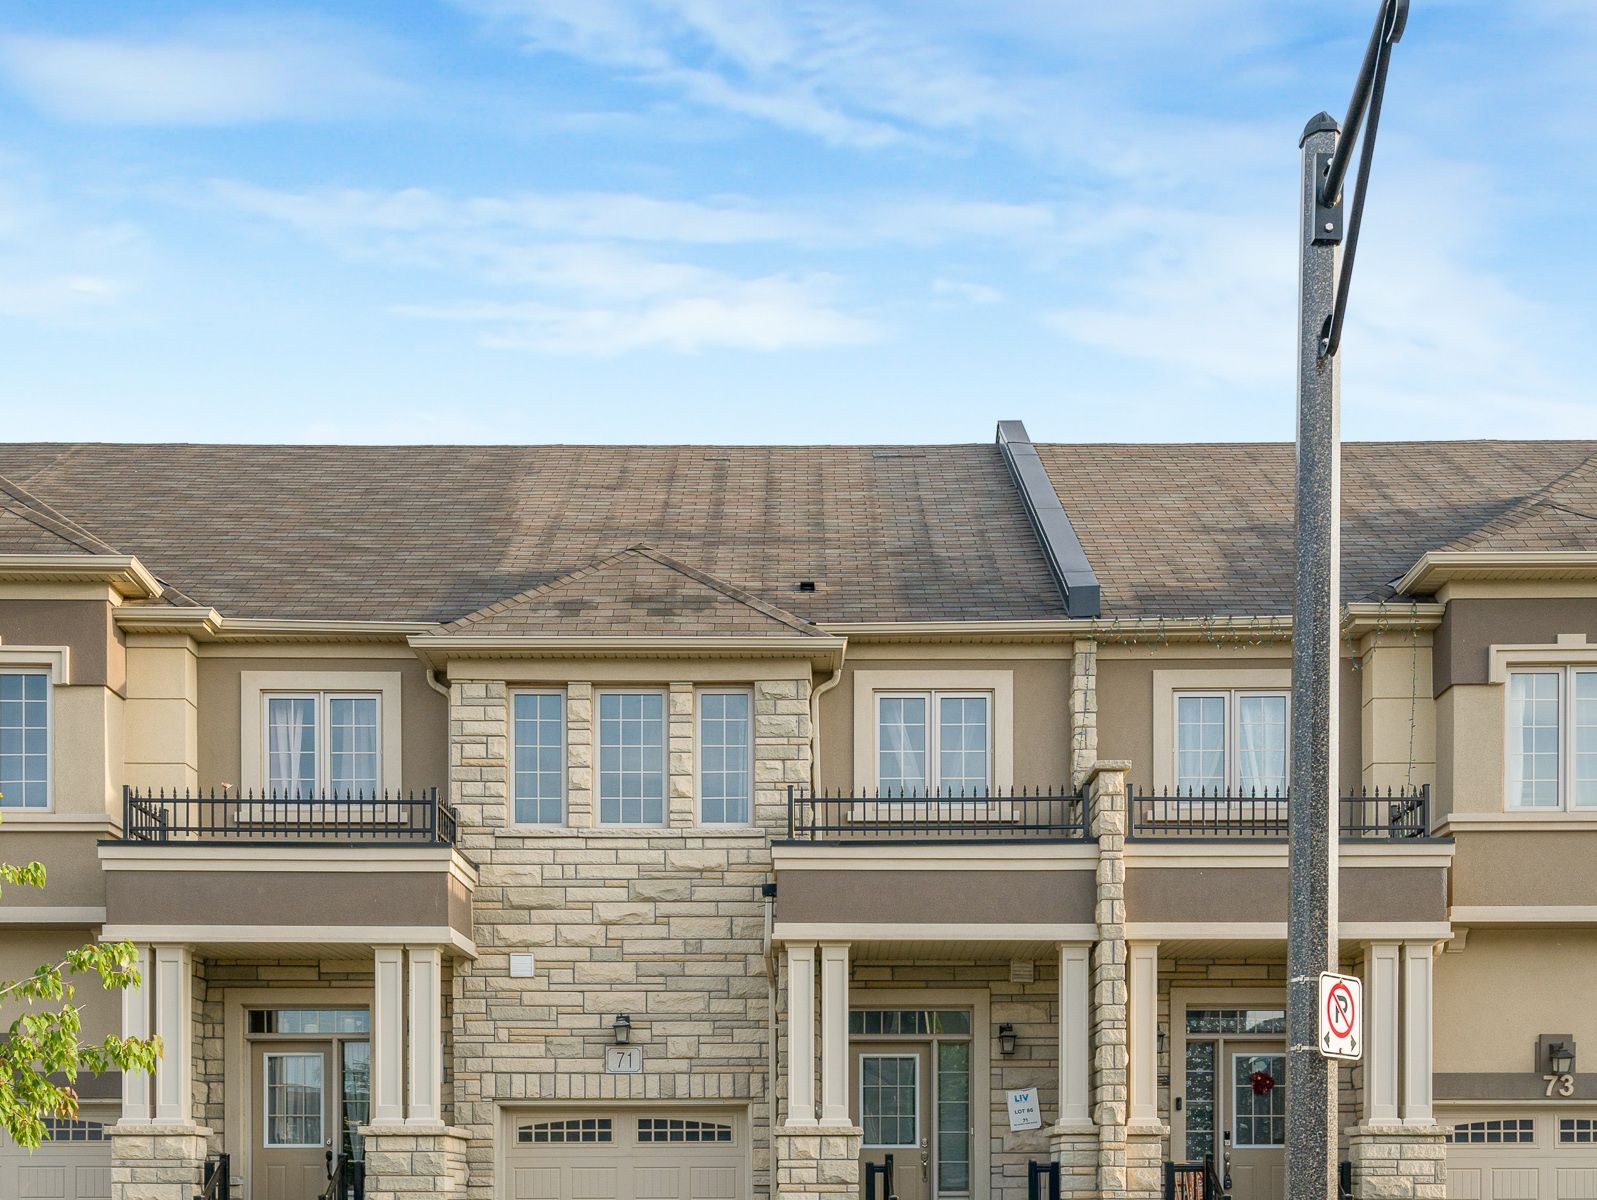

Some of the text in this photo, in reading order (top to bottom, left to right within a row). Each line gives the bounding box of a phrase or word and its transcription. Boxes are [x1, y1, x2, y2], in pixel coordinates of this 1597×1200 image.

[616, 1051, 632, 1069] 71
[1543, 1074, 1575, 1097] 73
[1014, 1094, 1029, 1102] LIV
